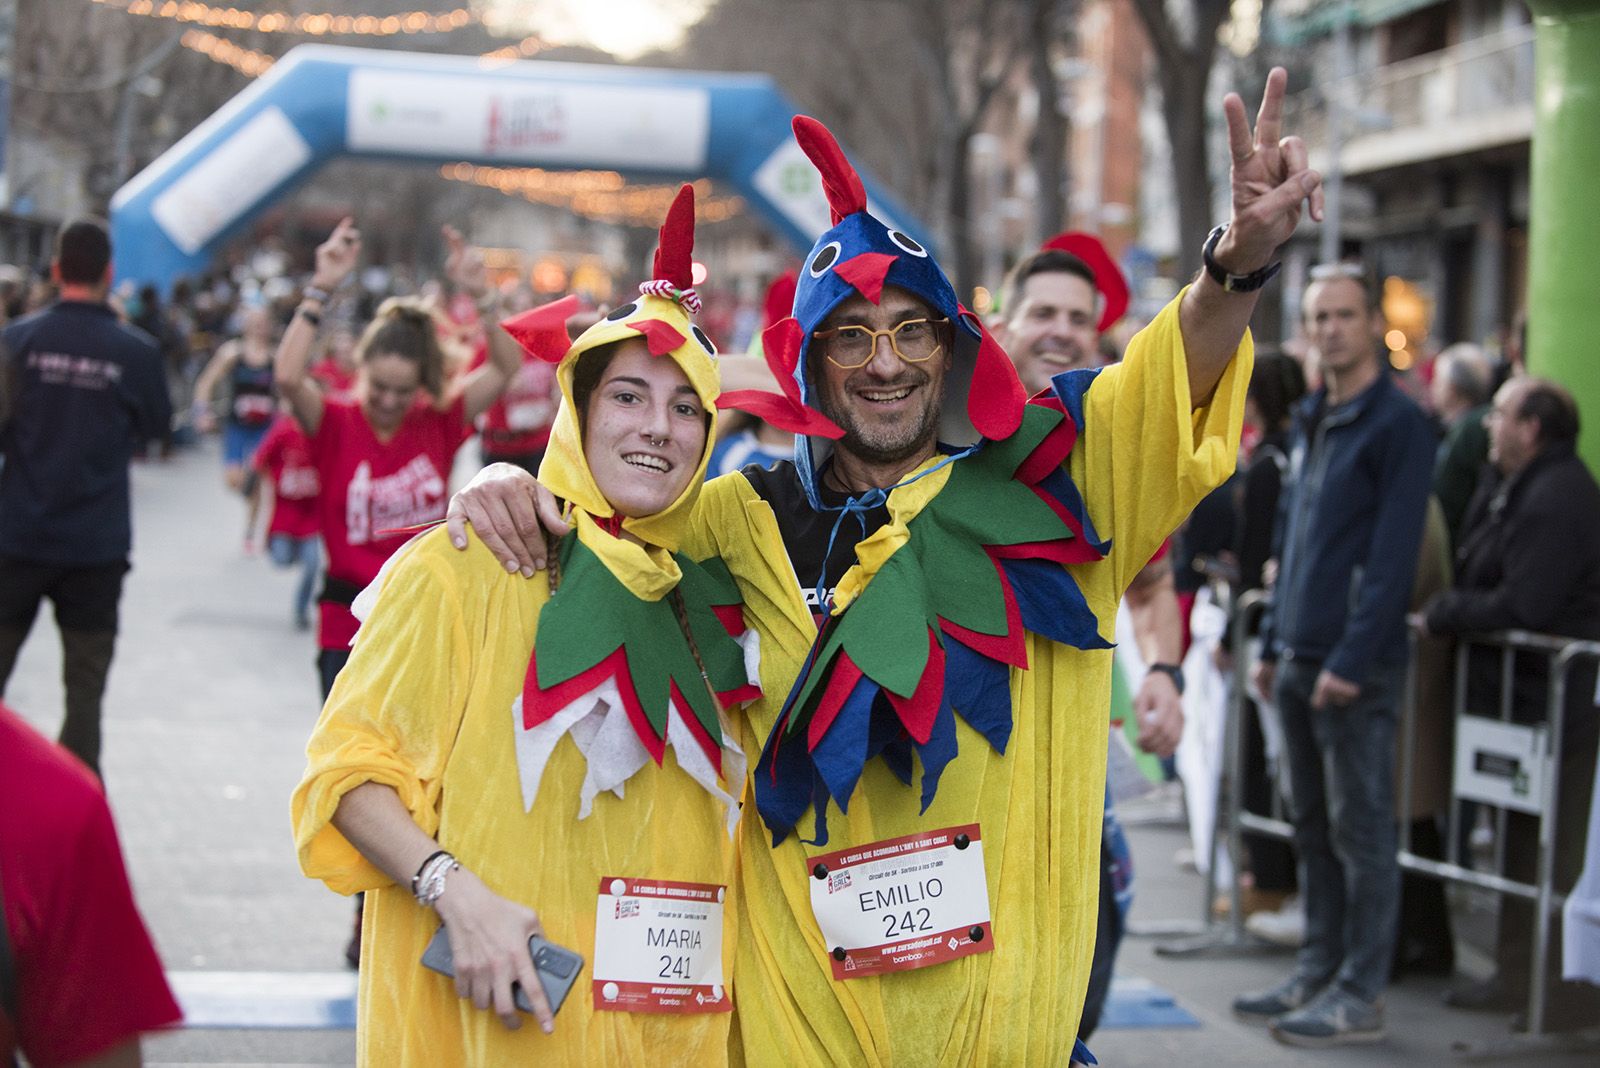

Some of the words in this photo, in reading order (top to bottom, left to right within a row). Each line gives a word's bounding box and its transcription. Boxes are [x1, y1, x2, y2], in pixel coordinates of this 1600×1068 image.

[840, 857, 847, 865] LA
[847, 853, 862, 863] CURSA
[863, 850, 873, 860] QUE
[859, 878, 943, 912] EMILIO
[882, 907, 933, 938] 242
[647, 927, 702, 949] MARIA
[659, 955, 691, 979] 241
